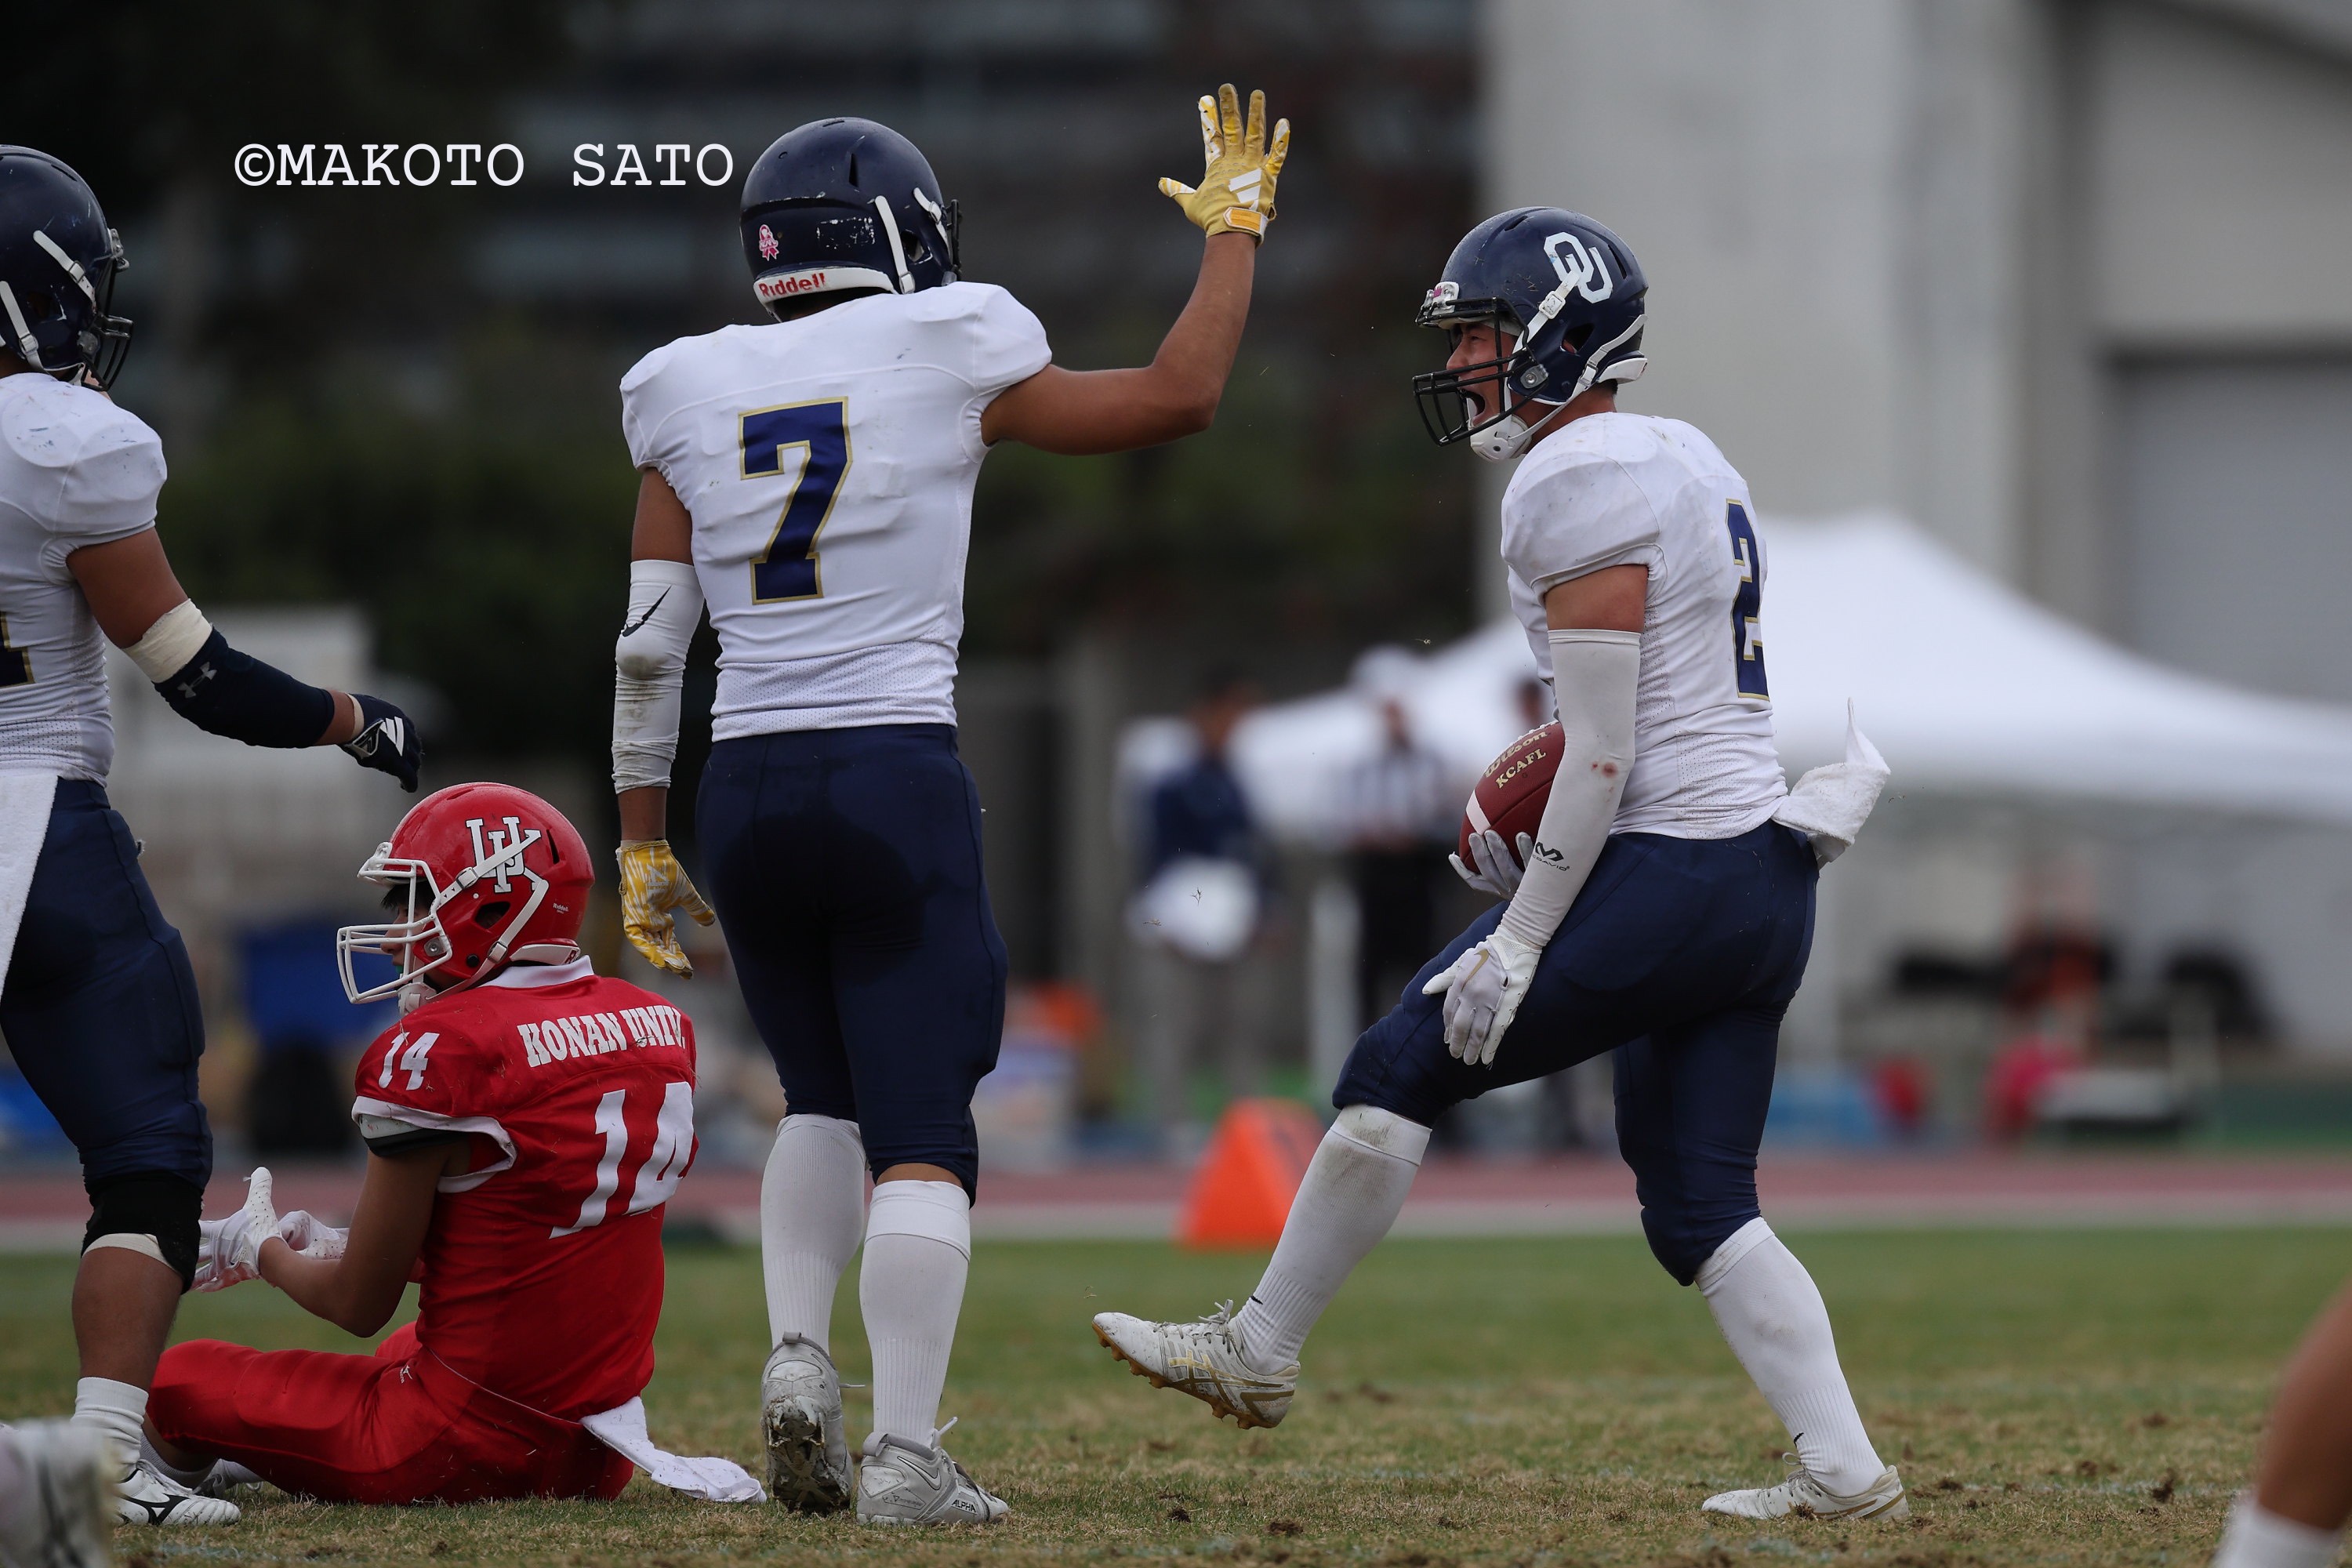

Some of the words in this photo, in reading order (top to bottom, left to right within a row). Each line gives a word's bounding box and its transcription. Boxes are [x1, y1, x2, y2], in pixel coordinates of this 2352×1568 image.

[758, 273, 826, 298] Riddell
[738, 396, 853, 604] 7
[1495, 749, 1546, 789] KCAFL
[378, 1032, 440, 1091] 14
[517, 1011, 628, 1068] KONAN
[549, 1081, 695, 1239] 14
[951, 1498, 977, 1513] ALPHA
